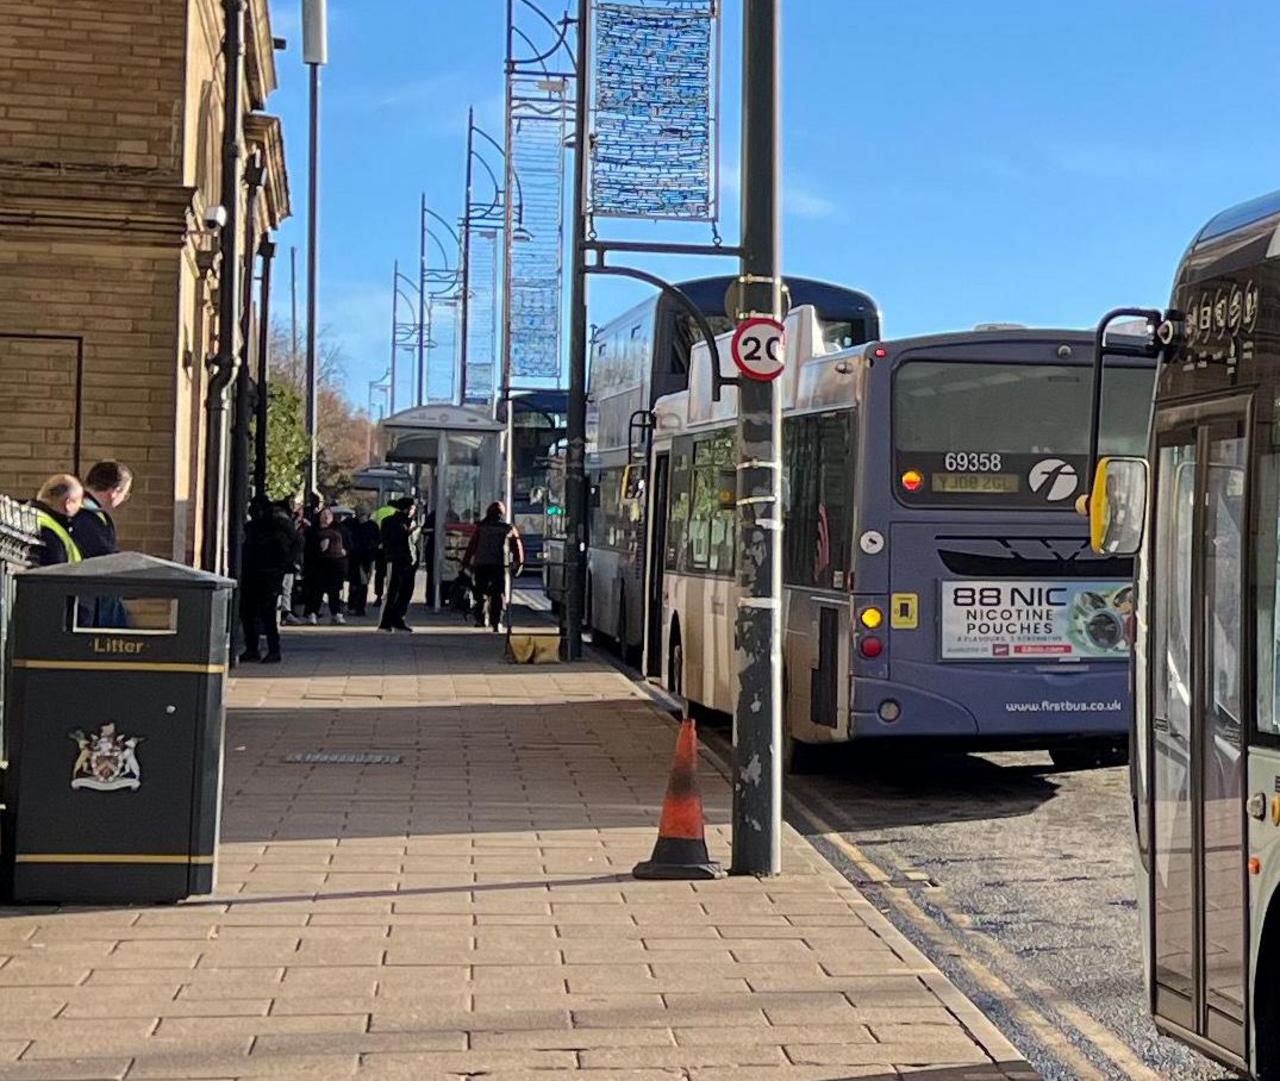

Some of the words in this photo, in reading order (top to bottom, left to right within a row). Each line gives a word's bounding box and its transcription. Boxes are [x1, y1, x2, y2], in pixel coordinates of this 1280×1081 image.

[944, 452, 1002, 472] 69358
[953, 587, 1002, 607] 88
[1010, 587, 1068, 607] NIC
[966, 609, 1054, 621] NICOTINE
[966, 622, 1054, 635] POUCHES
[93, 637, 145, 654] Litter
[1006, 699, 1122, 713] www.firstbus.co.uk
